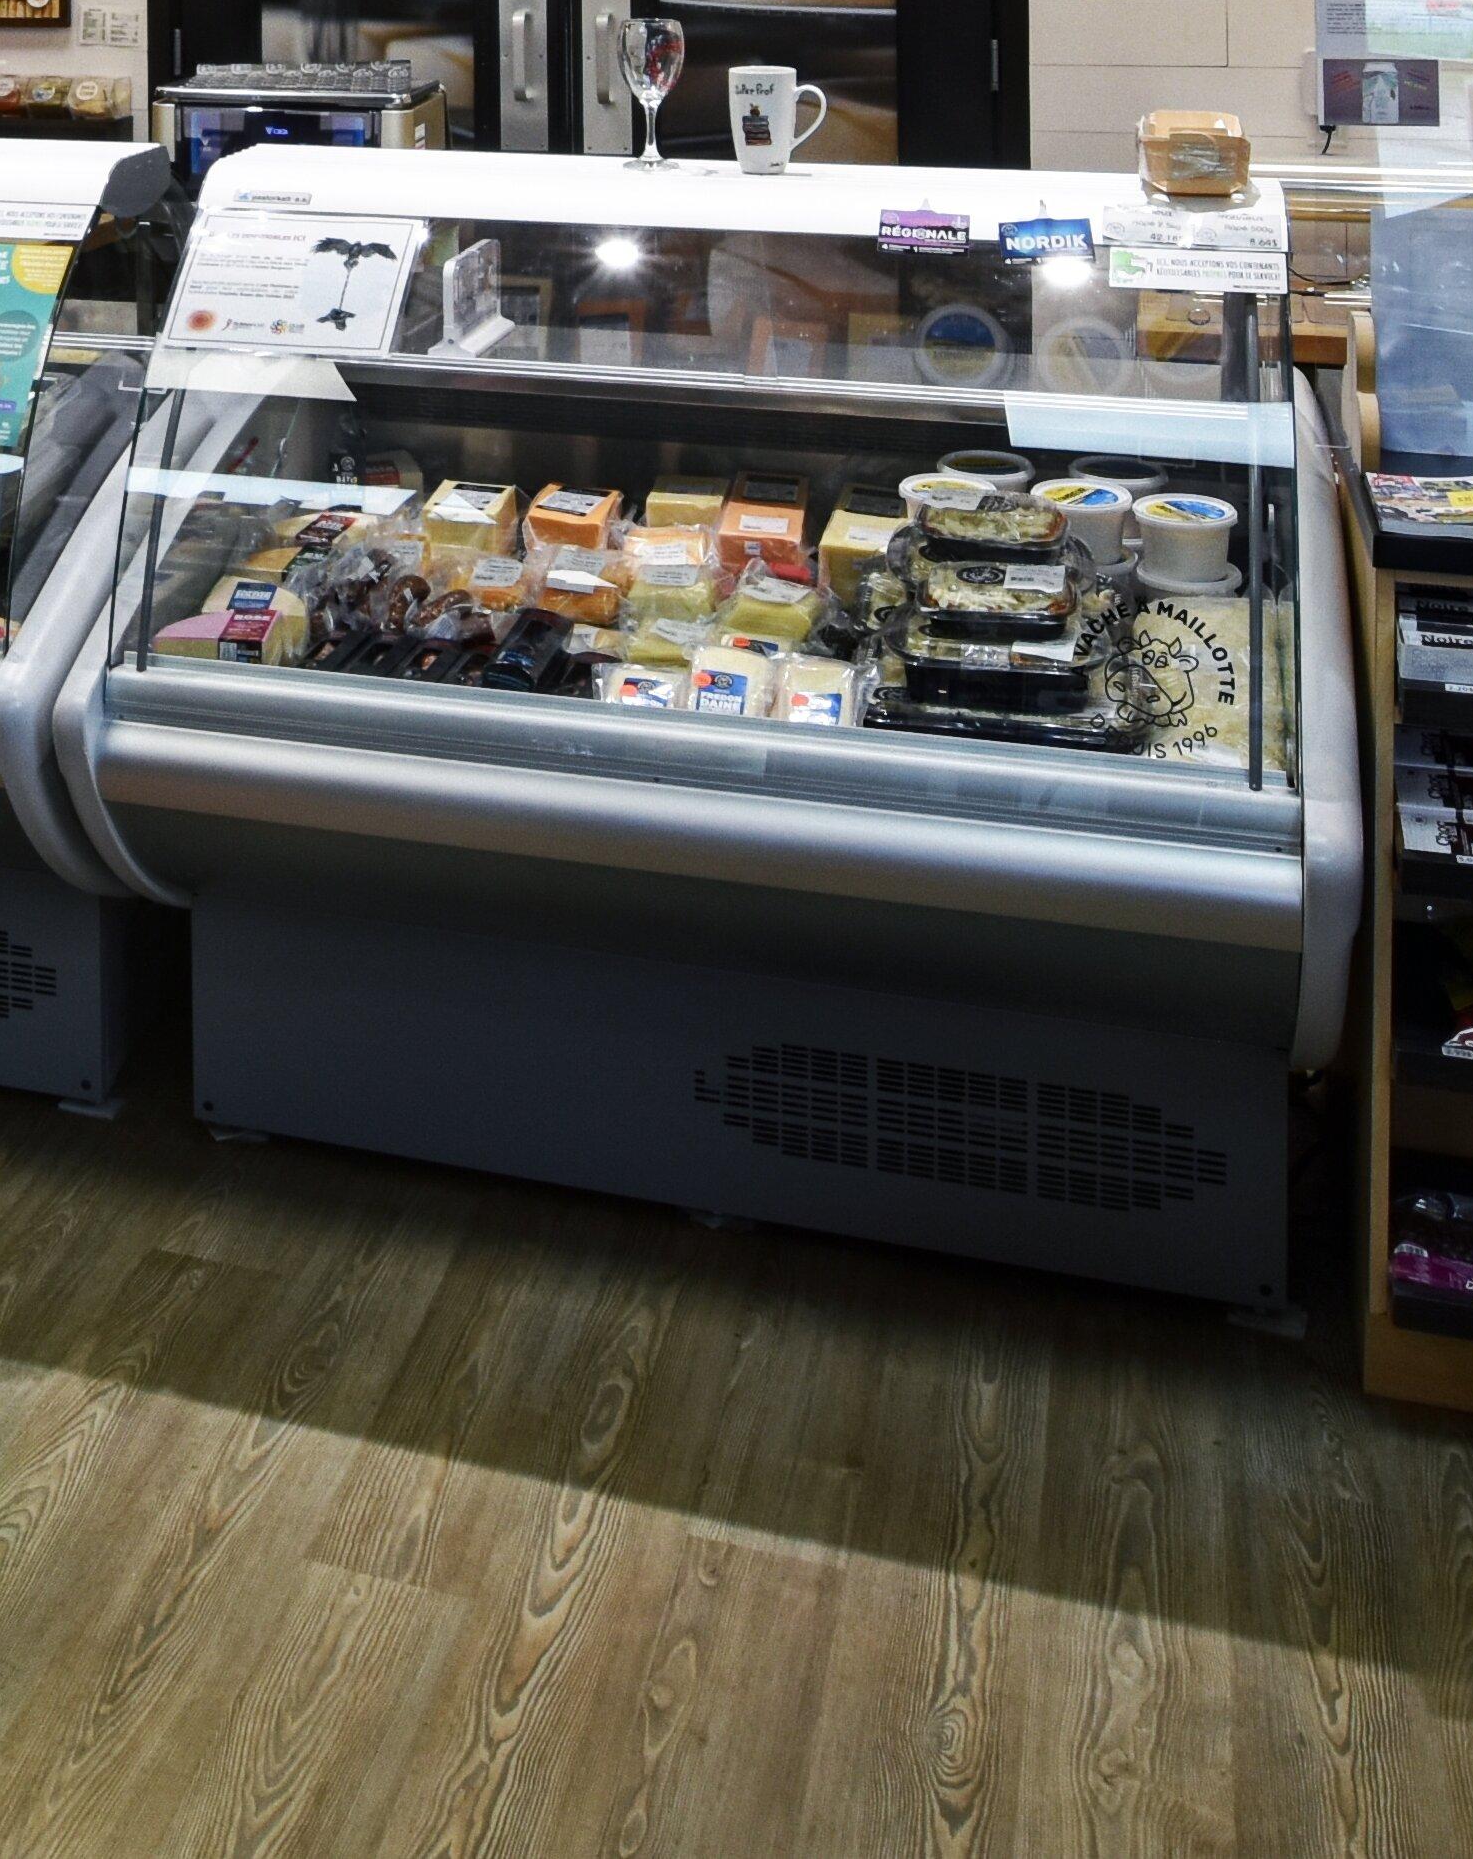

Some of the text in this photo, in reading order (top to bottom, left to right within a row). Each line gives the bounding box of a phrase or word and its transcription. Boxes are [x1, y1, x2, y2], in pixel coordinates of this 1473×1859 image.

[881, 223, 967, 243] RÉGIONALE
[1006, 233, 1087, 252] NORDIK
[1421, 633, 1473, 646] Noire
[1157, 601, 1236, 706] MAILLOTTE
[1173, 724, 1218, 756] 1996
